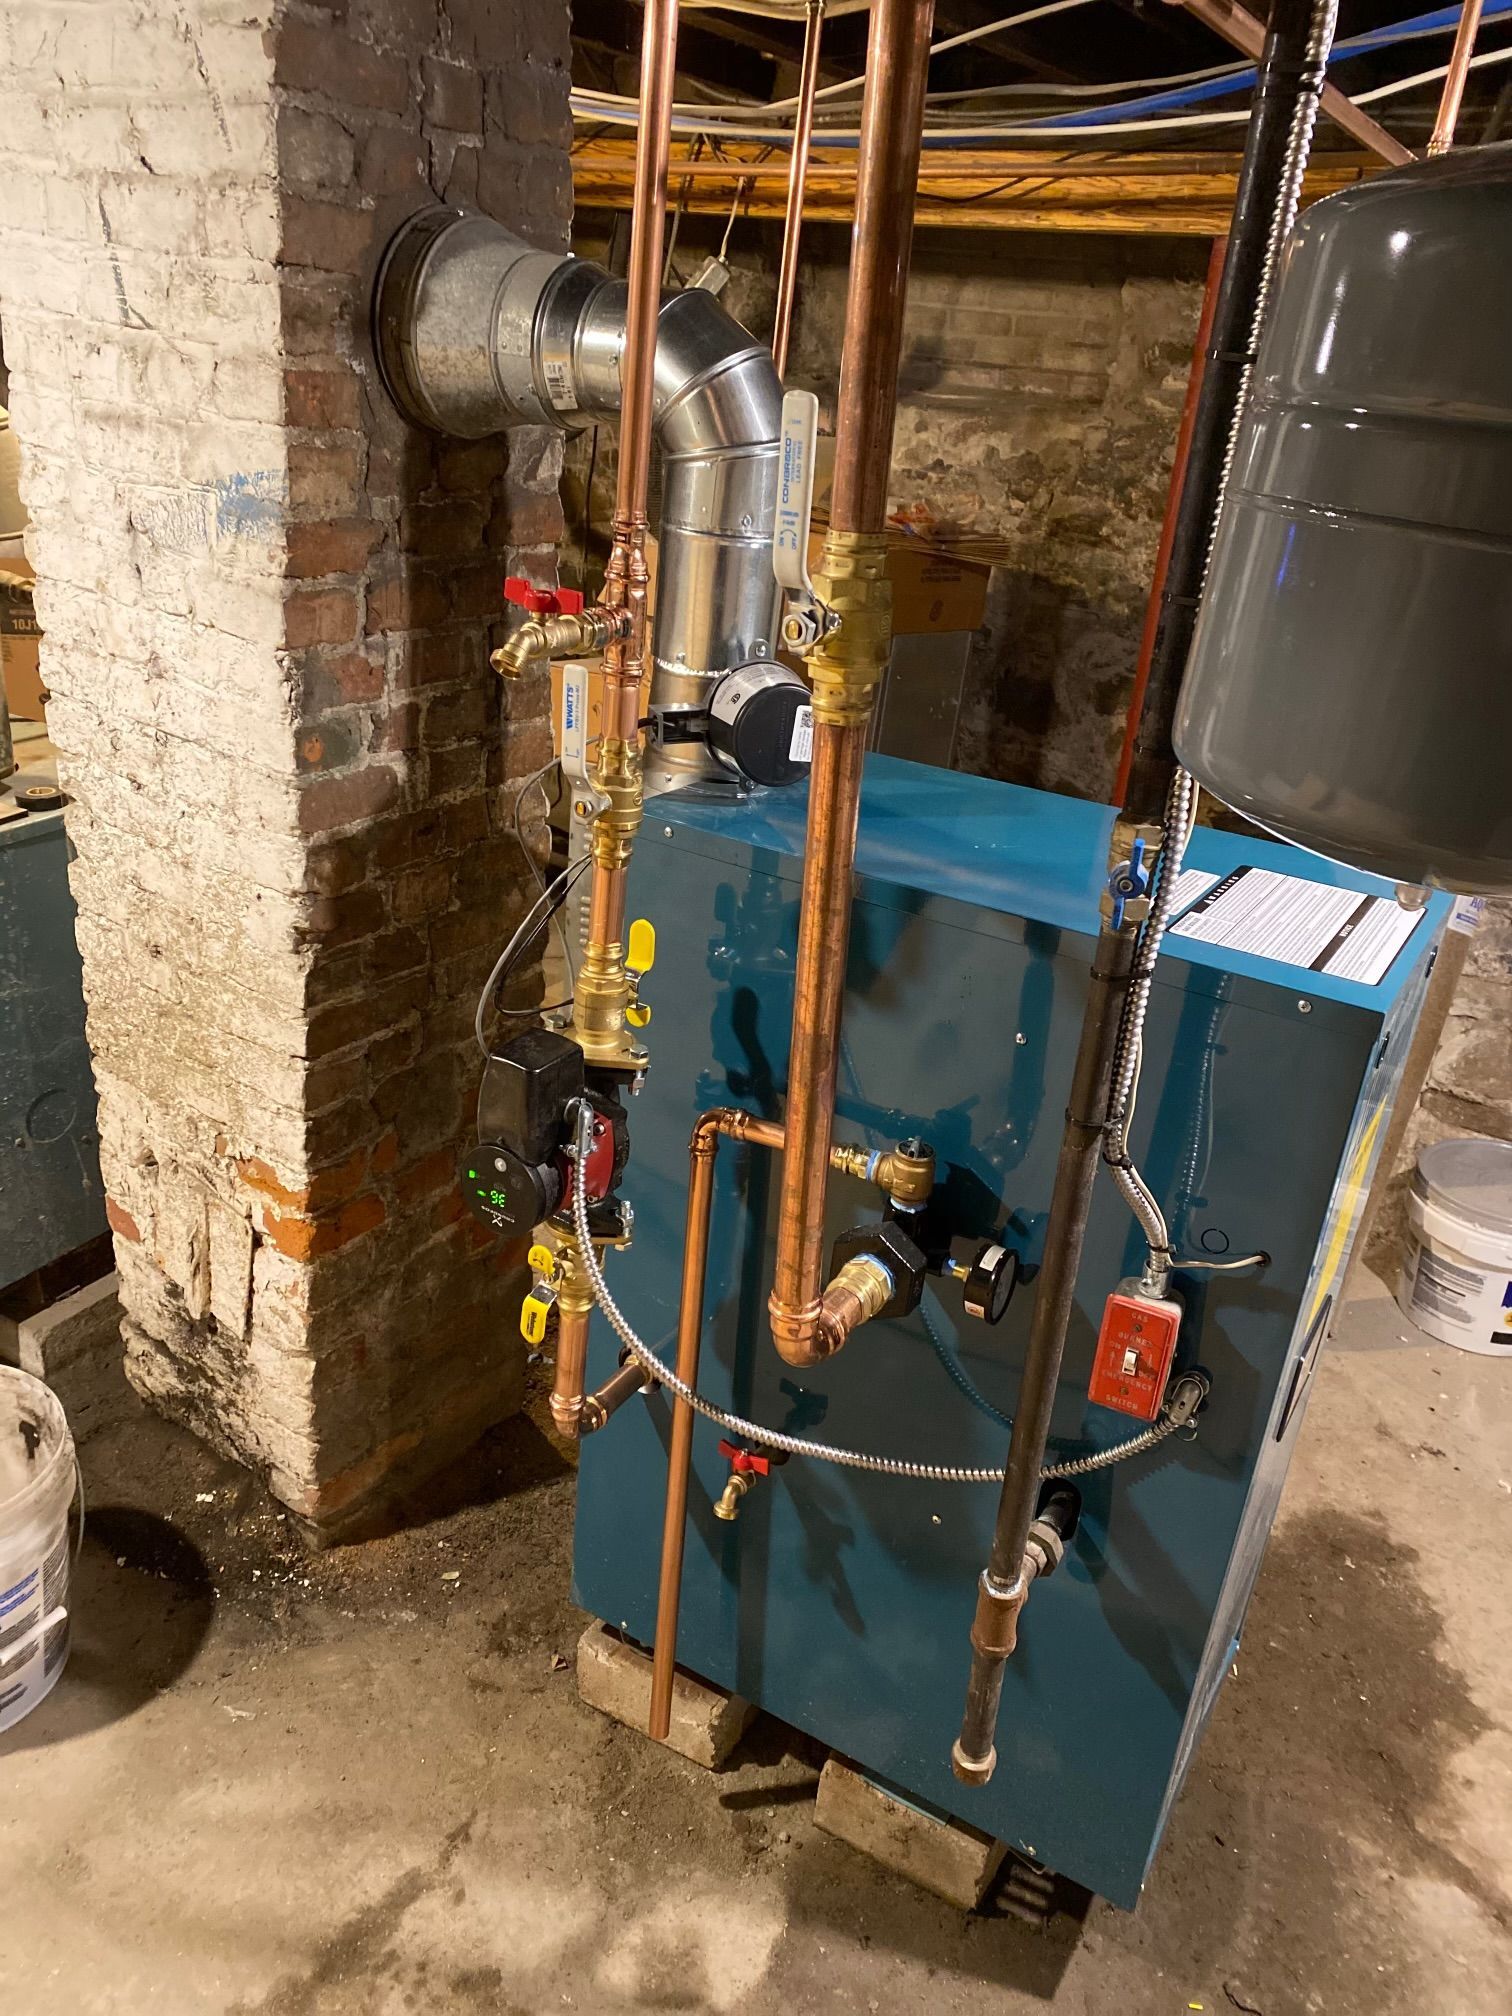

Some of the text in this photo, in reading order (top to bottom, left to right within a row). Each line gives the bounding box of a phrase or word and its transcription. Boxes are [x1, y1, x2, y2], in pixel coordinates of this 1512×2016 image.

[566, 686, 574, 718] WATTS
[1131, 1312, 1149, 1323] GAS
[1105, 1393, 1139, 1411] SWITCH
